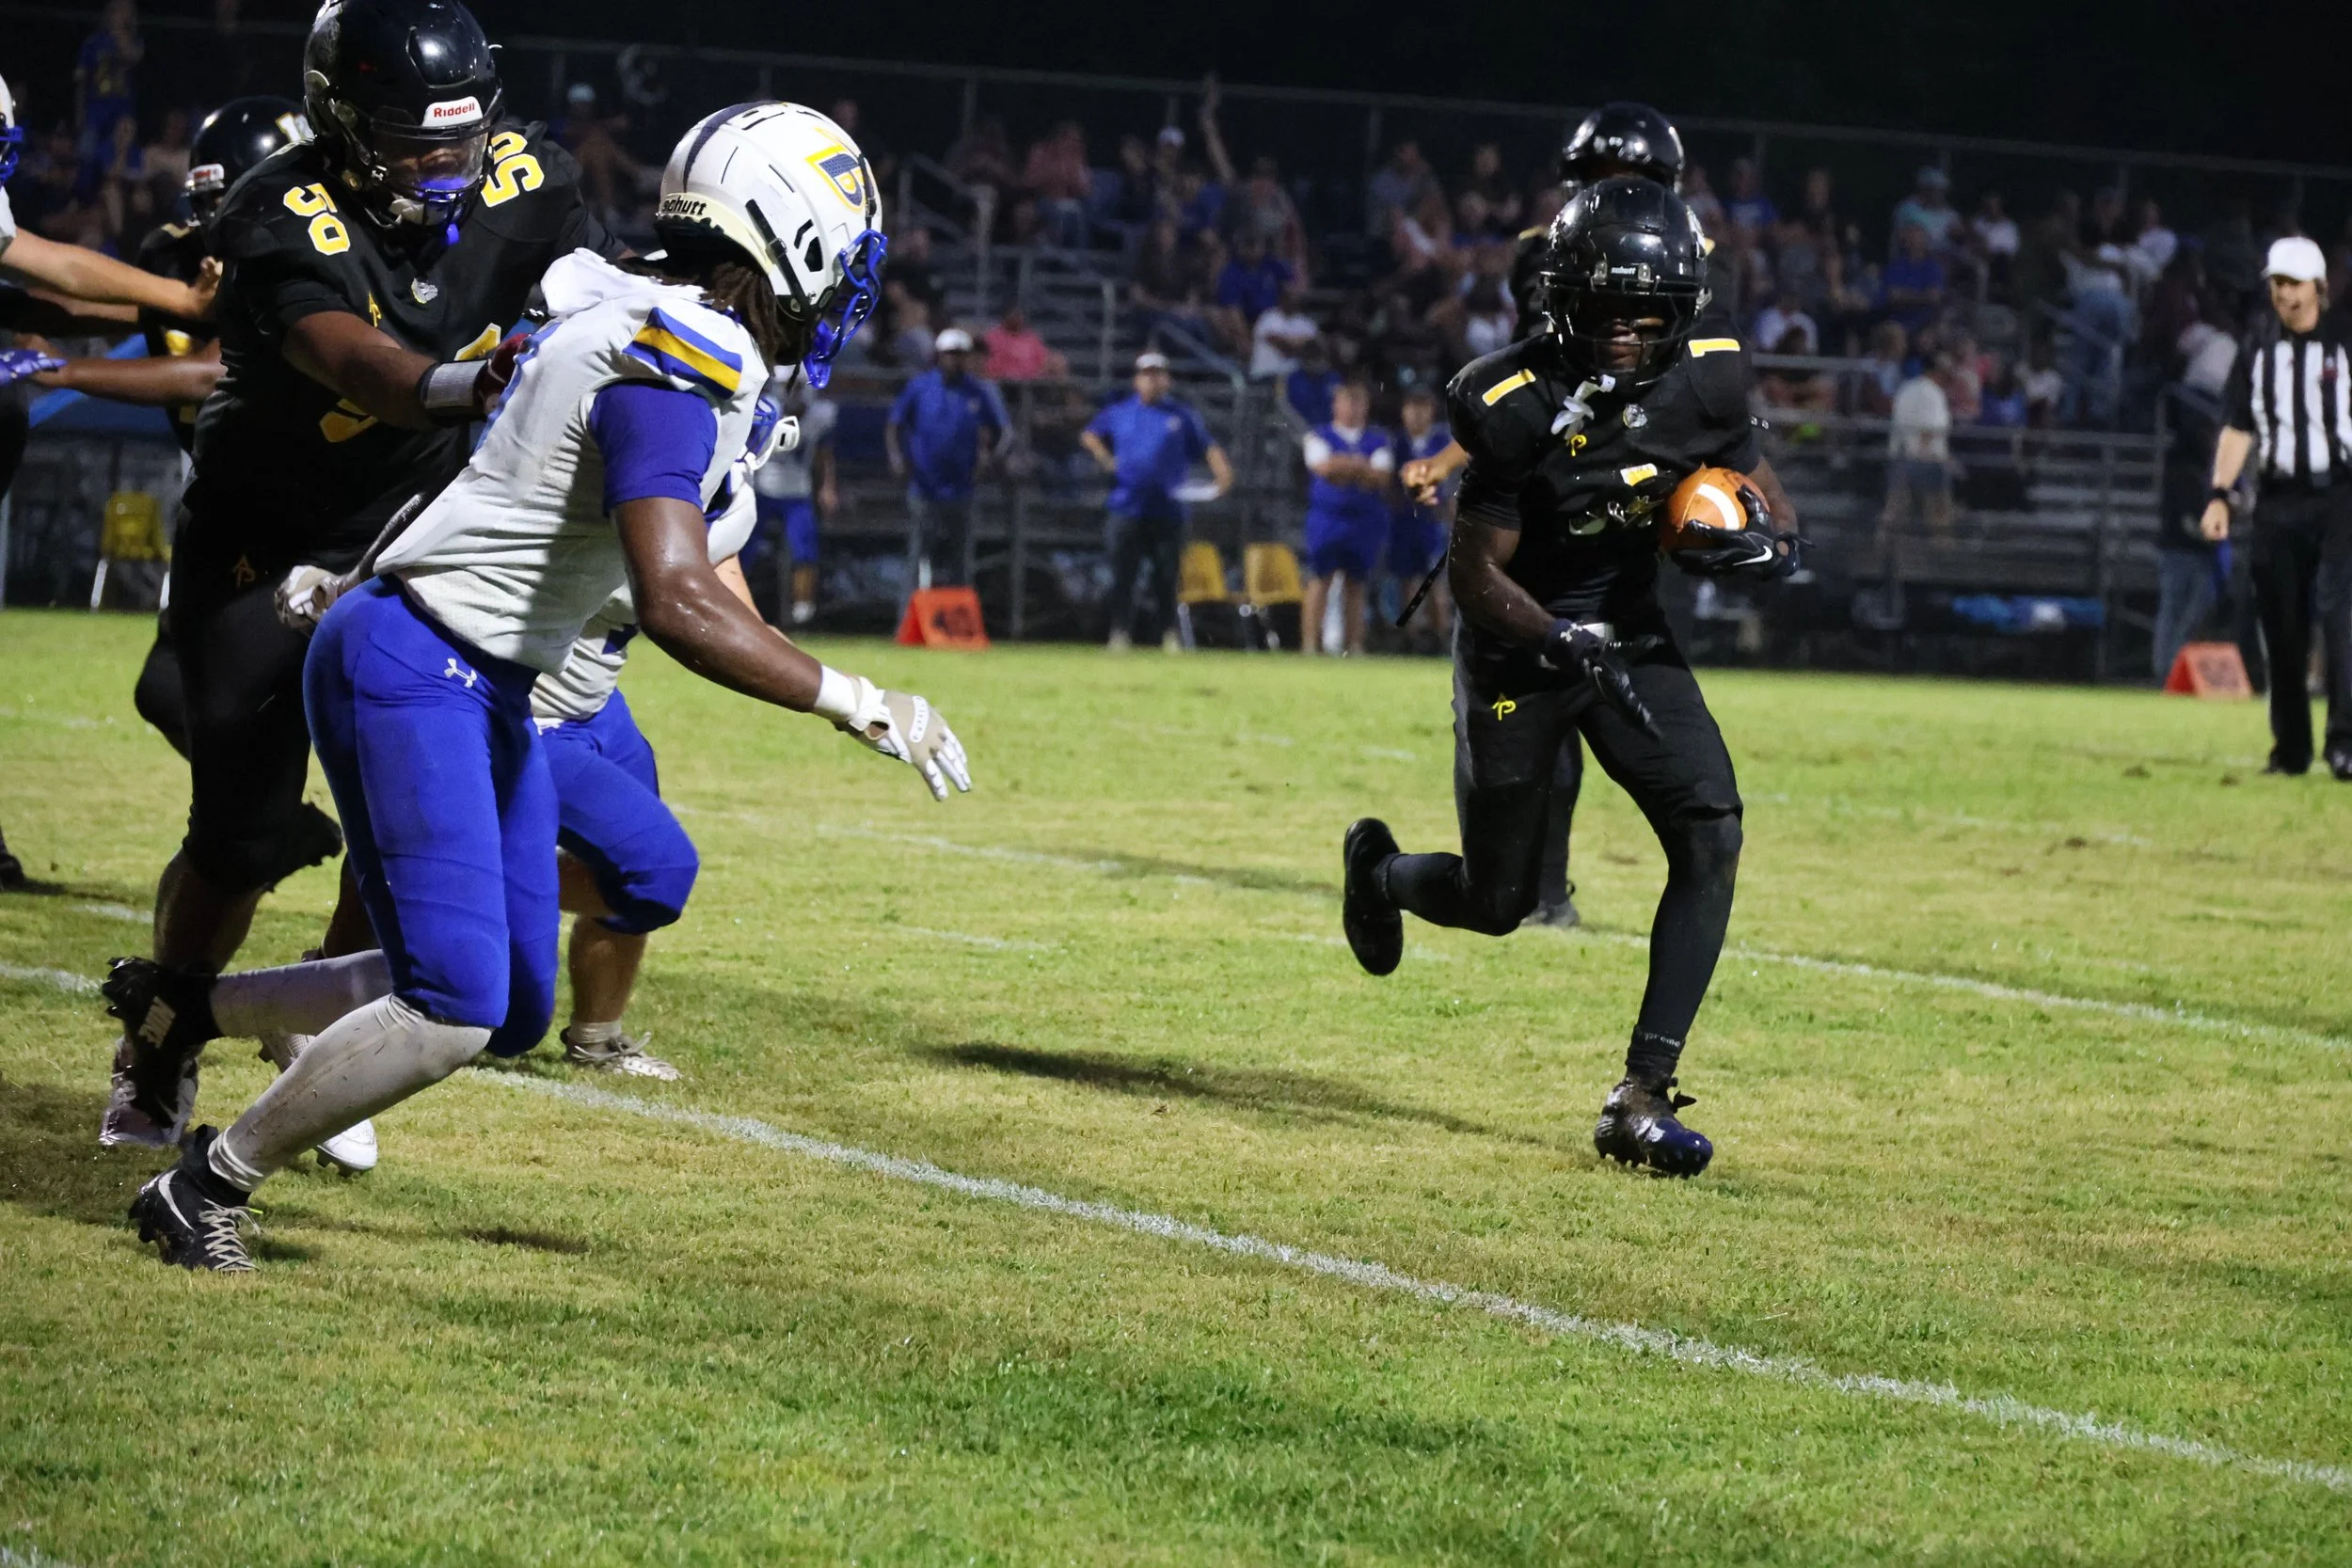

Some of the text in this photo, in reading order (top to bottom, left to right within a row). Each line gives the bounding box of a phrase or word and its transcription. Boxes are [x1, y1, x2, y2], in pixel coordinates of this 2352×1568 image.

[433, 103, 475, 118] Riddell
[661, 195, 707, 215] schutt
[282, 182, 351, 256] 50
[1688, 338, 1740, 357] 1
[1482, 368, 1536, 406] 1
